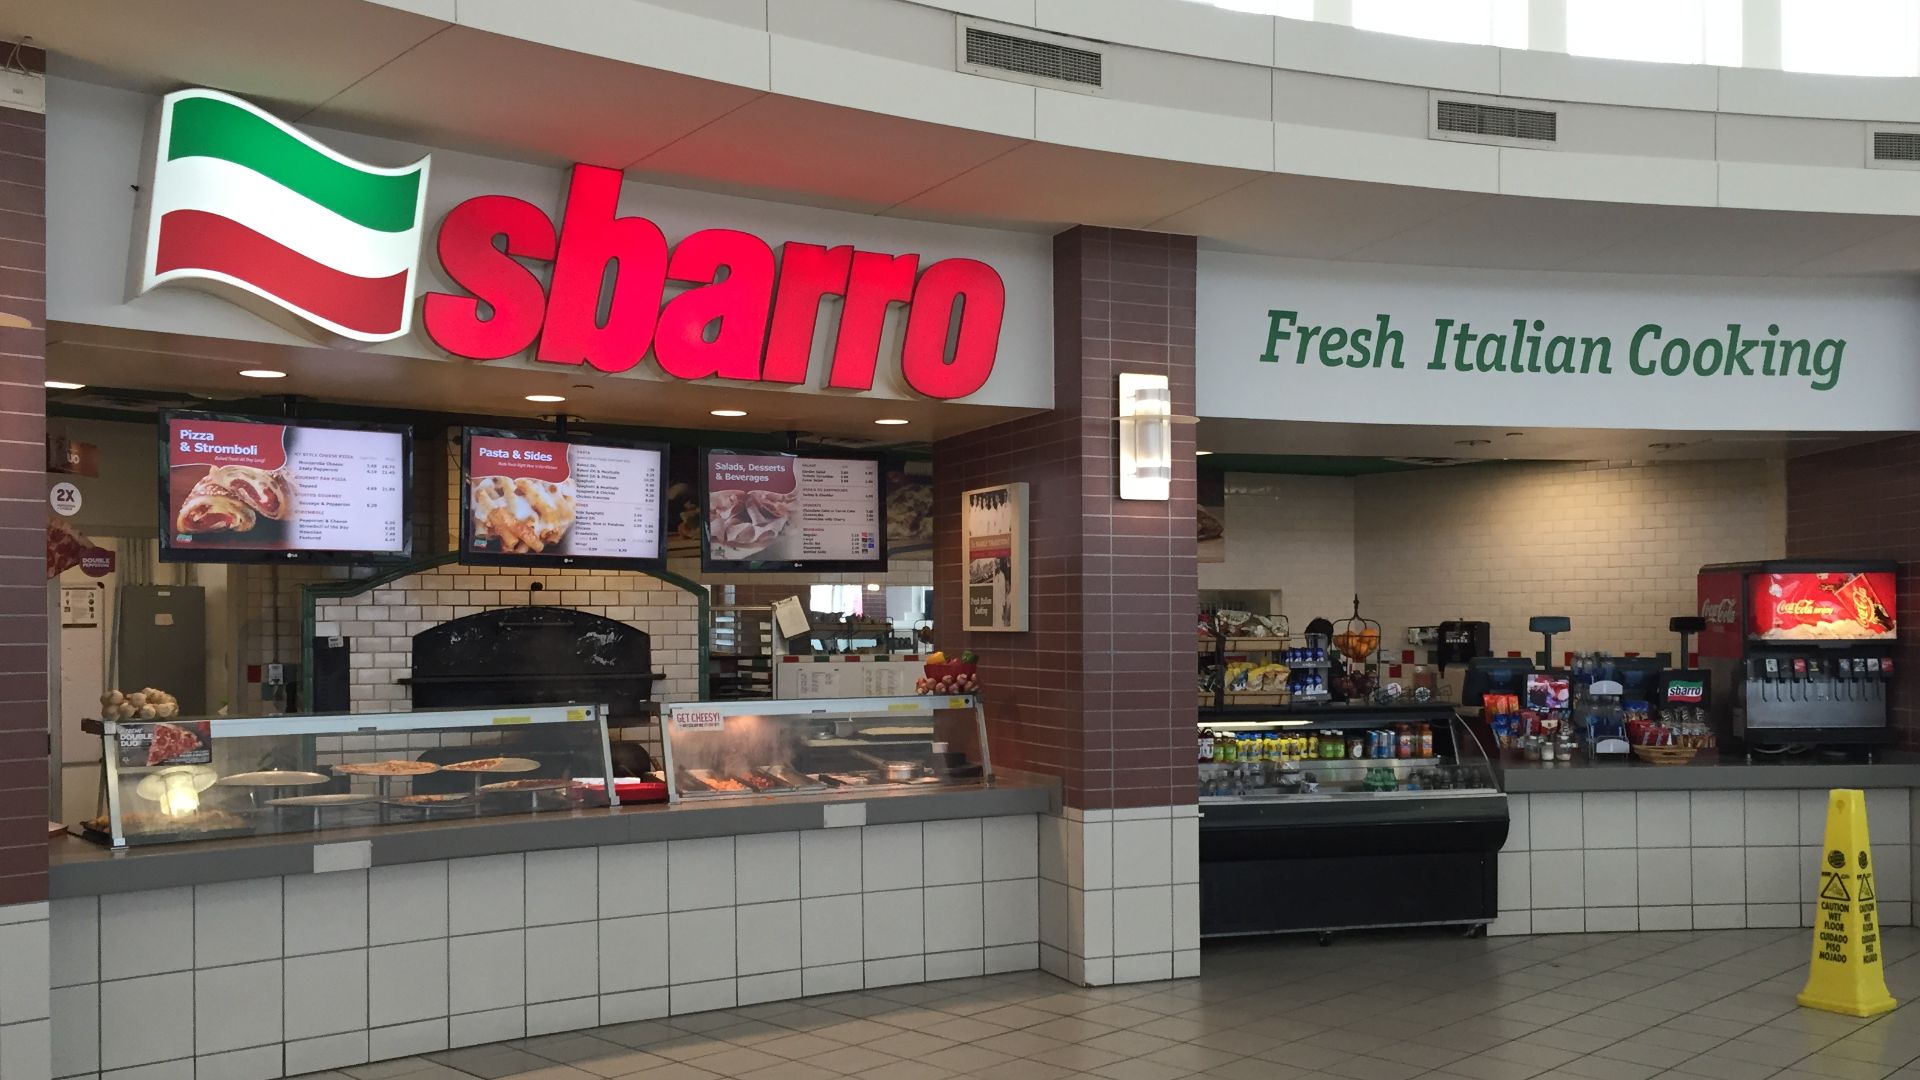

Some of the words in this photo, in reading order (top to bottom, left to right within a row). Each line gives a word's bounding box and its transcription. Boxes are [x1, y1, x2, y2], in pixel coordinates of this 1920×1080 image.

[423, 163, 1006, 400] sbarro
[1259, 309, 1406, 369] Fresh
[1427, 318, 1613, 375] Italian
[1629, 323, 1847, 392] Cooking
[180, 429, 214, 441] Pizza
[180, 441, 191, 452] &
[194, 443, 258, 455] Stromboli
[479, 447, 510, 458] Pasta
[512, 449, 521, 460] &
[524, 450, 552, 462] Sides
[715, 462, 746, 472] Salads,
[748, 463, 786, 472] Desserts
[725, 473, 769, 483] Beverages
[56, 488, 75, 503] 2X
[1669, 685, 1701, 695] sbarro
[676, 713, 690, 723] GET
[691, 712, 720, 722] CHEESY!
[1821, 901, 1850, 913] CAUTION
[1828, 912, 1842, 921] WET
[1824, 921, 1844, 932] FLOOR
[1820, 932, 1848, 944] CUIDADO
[1826, 943, 1841, 952] PISO
[1819, 951, 1847, 964] MOJADO
